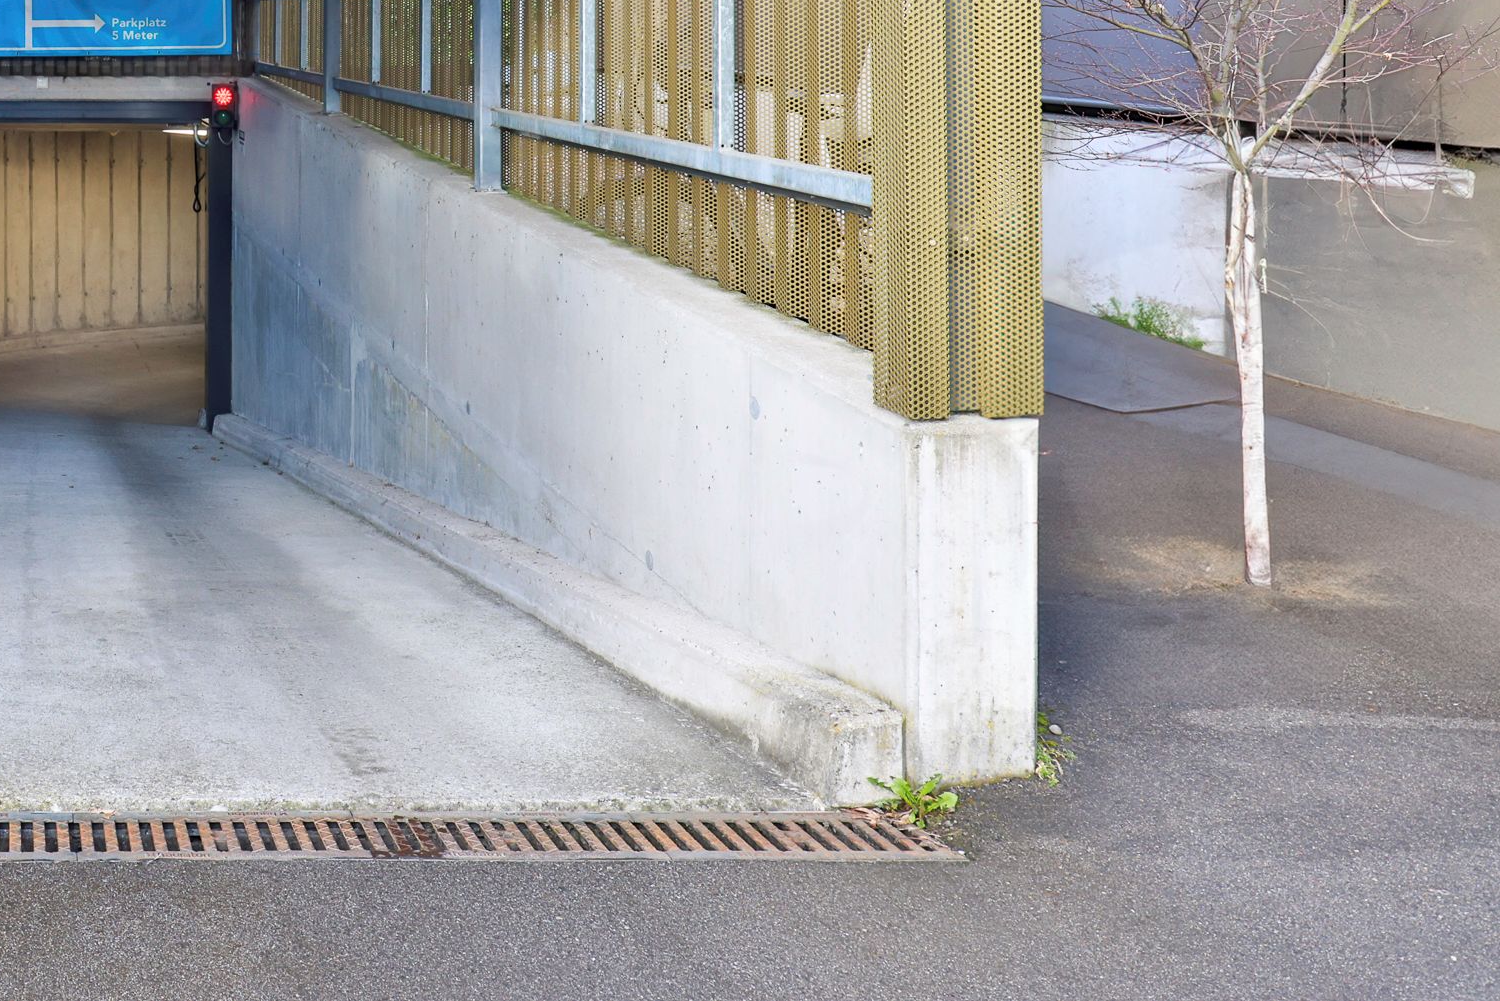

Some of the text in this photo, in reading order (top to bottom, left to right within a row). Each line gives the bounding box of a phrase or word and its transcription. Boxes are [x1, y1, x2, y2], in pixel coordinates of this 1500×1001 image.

[112, 17, 167, 30] Parkplatz
[112, 30, 159, 40] 5 Meter
